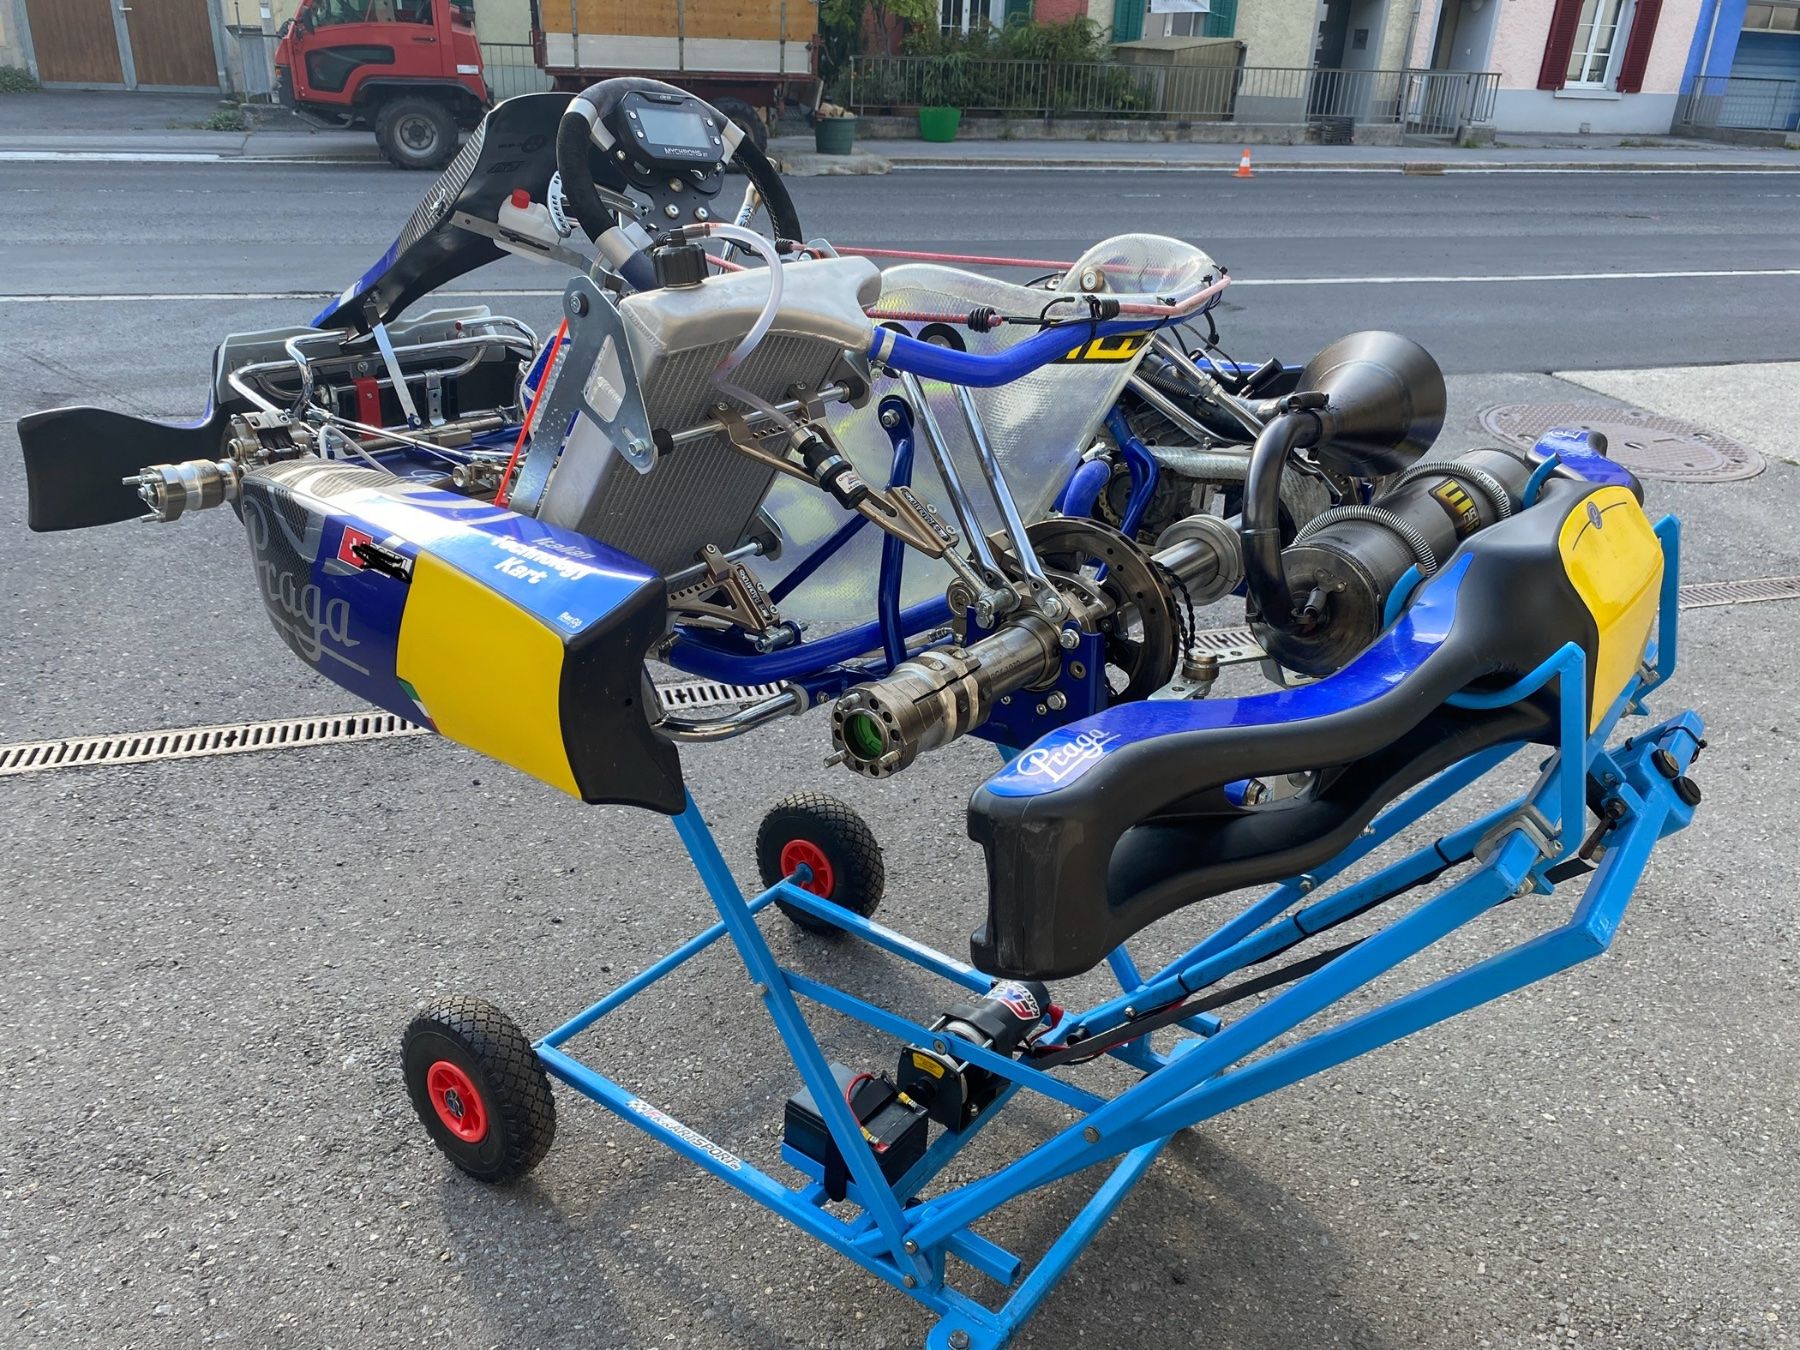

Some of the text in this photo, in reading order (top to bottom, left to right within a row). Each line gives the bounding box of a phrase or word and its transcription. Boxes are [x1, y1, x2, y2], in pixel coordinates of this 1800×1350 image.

[491, 535, 592, 581] Technology
[493, 556, 548, 584] Kart
[531, 537, 597, 560] Italian
[243, 495, 370, 676] Praga
[1017, 728, 1121, 783] Praga
